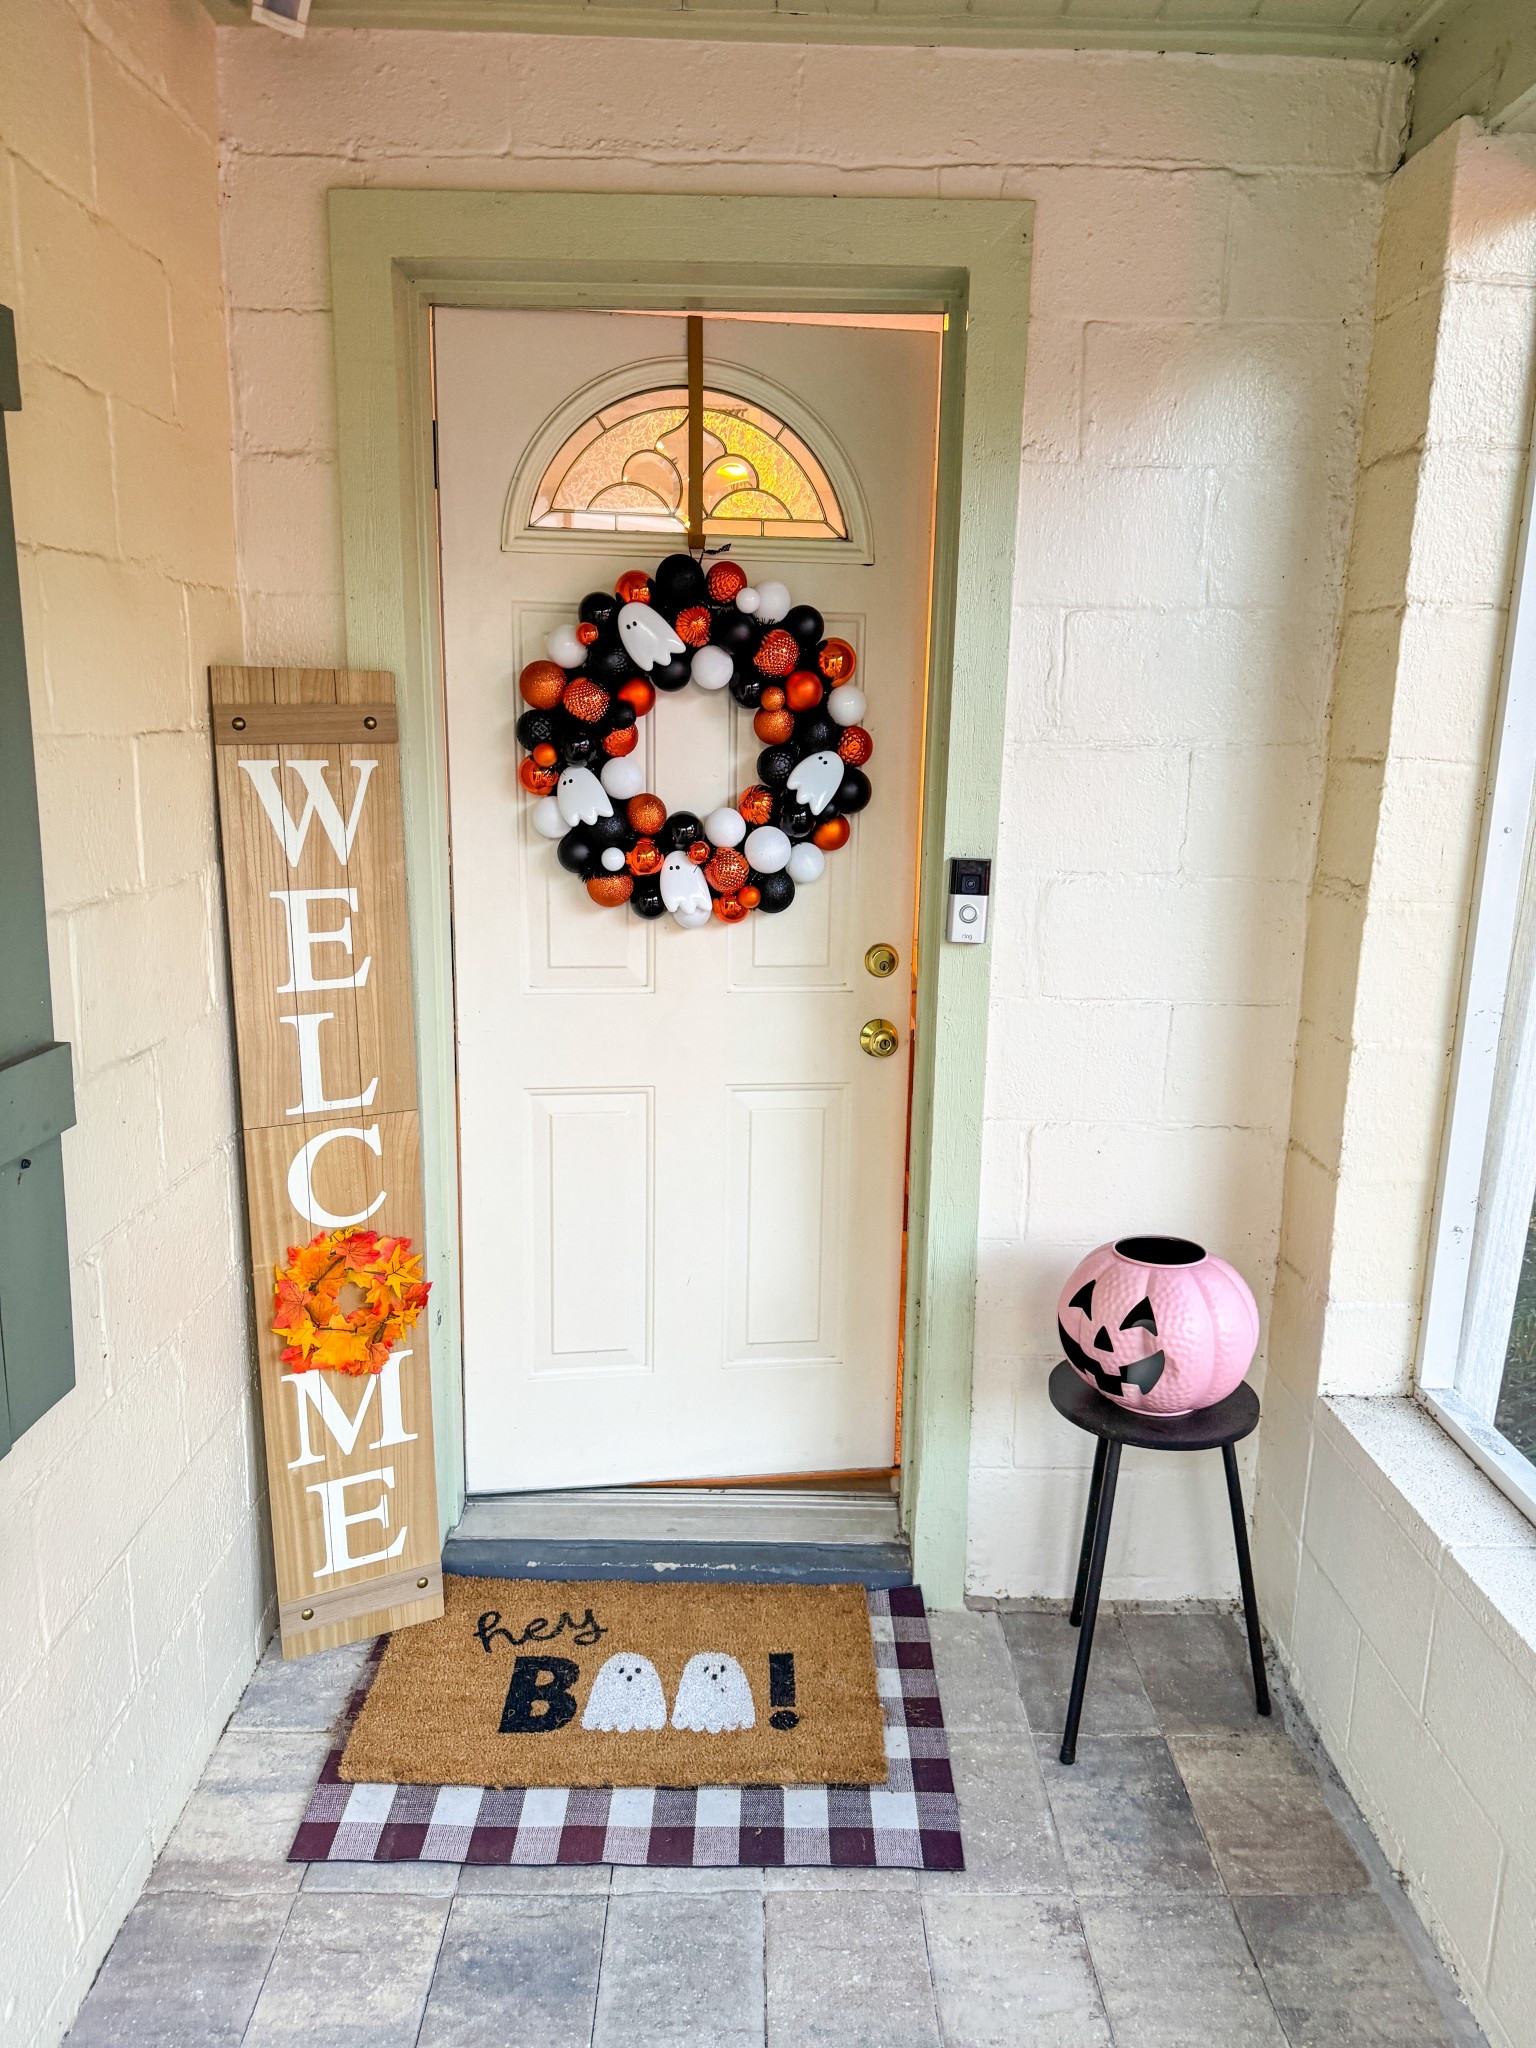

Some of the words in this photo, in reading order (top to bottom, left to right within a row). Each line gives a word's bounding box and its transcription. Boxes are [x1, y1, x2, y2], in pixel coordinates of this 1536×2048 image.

[237, 758, 418, 1578] WELCME
[474, 1607, 608, 1653] hey
[498, 1651, 797, 1734] B!
